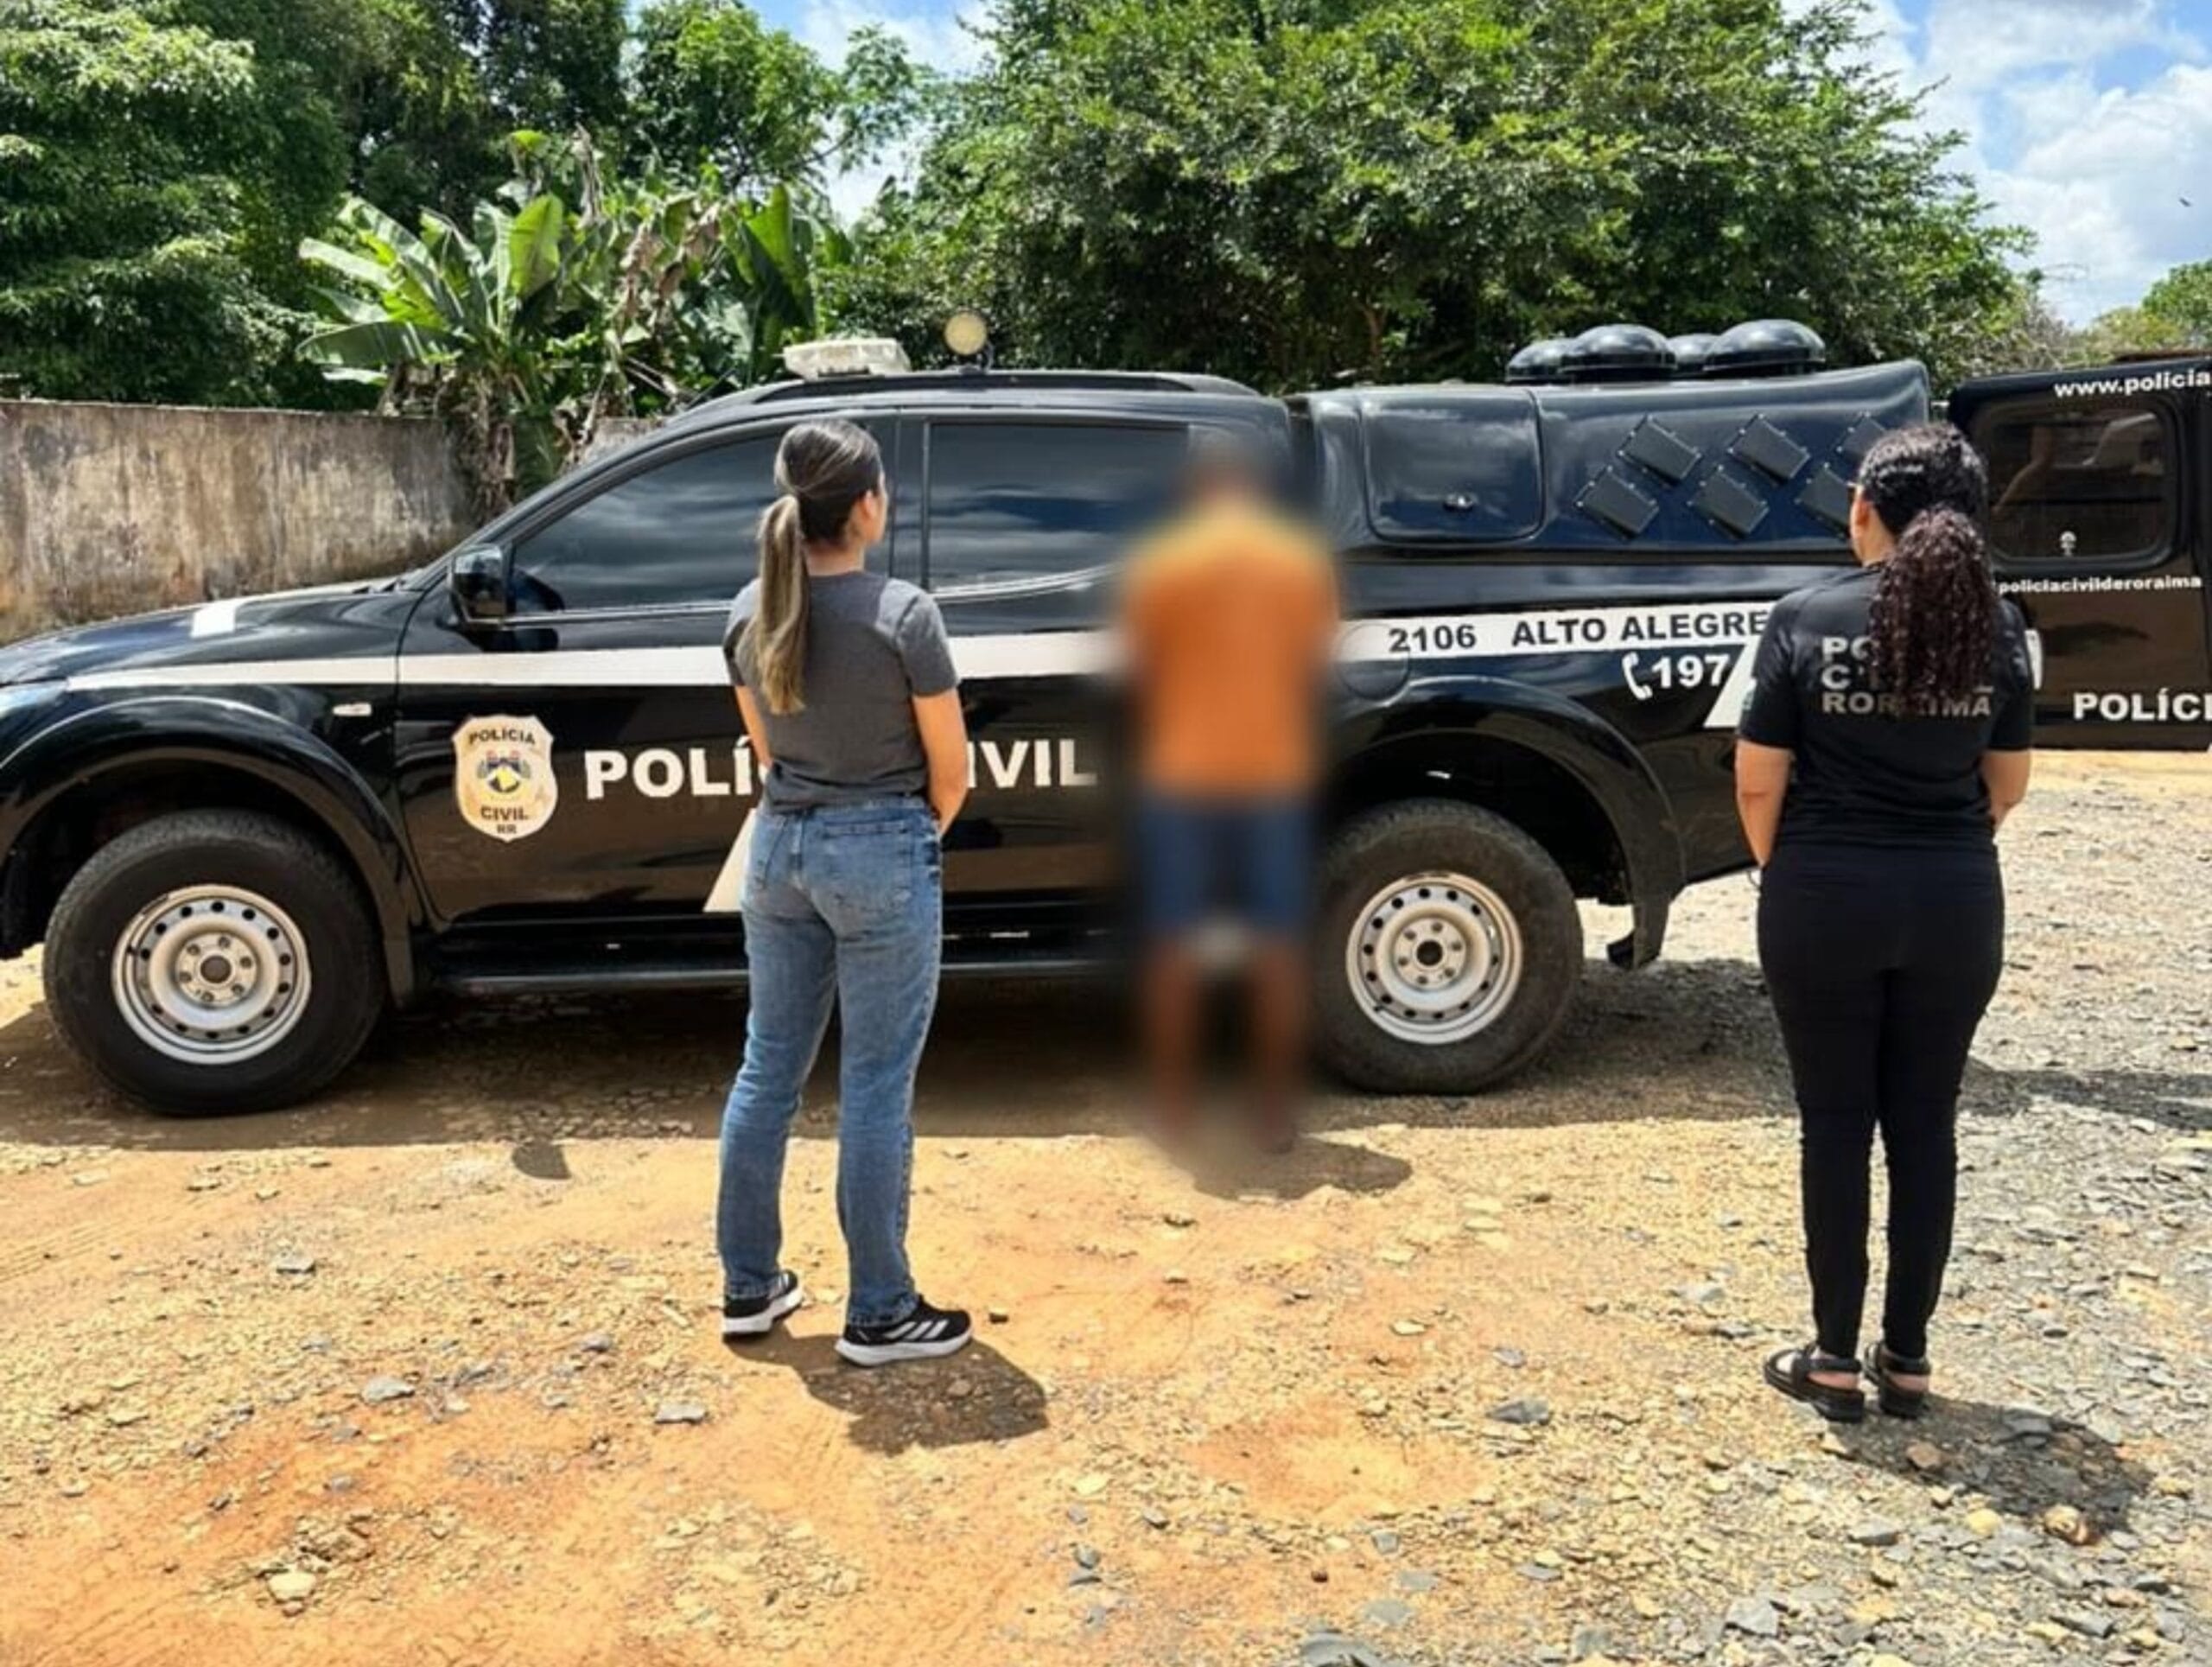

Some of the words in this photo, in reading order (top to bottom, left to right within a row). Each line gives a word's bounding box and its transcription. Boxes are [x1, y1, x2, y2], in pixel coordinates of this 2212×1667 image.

[2054, 369, 2212, 398] www.policia
[1388, 624, 1476, 652] 2106
[1511, 618, 1606, 646] ALTO
[1621, 610, 1769, 641] ALEGRE
[1651, 653, 1730, 689] 197
[1821, 691, 1991, 716] RORIMA
[584, 735, 768, 800] POLÍ
[966, 739, 1096, 789] IVIL
[480, 805, 529, 821] CIVIL
